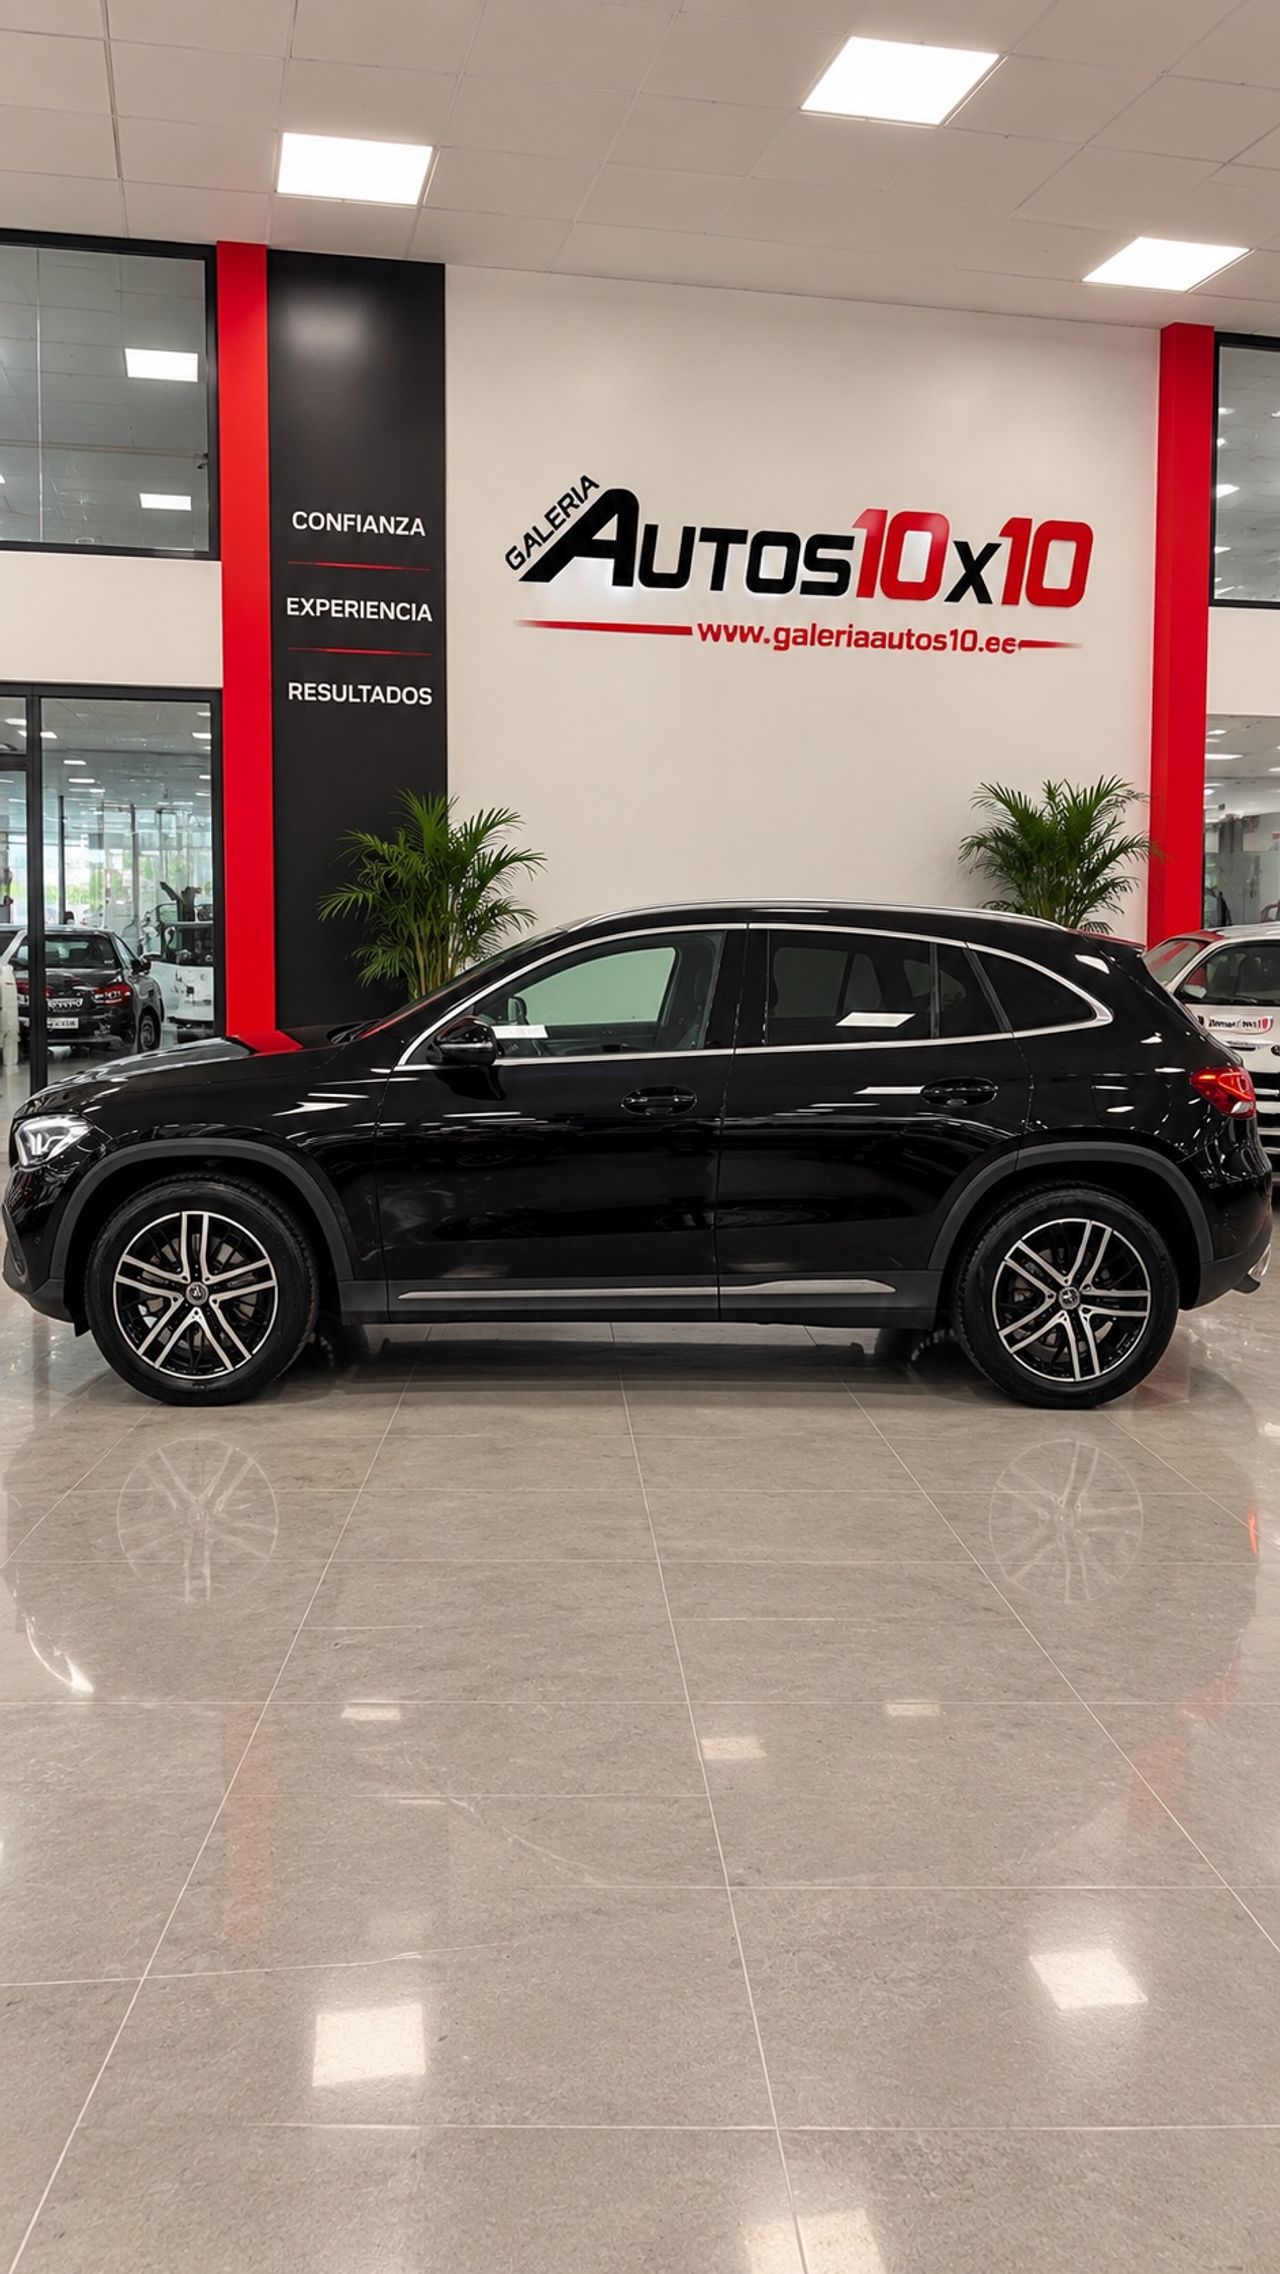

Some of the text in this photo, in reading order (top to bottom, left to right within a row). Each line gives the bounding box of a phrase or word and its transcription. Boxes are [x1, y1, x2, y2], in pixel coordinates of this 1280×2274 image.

[292, 511, 426, 537] CONFIANZA
[505, 475, 600, 572] GALERIA
[286, 597, 433, 622] EXPERIENCIA
[288, 682, 433, 706] RESULTADOS
